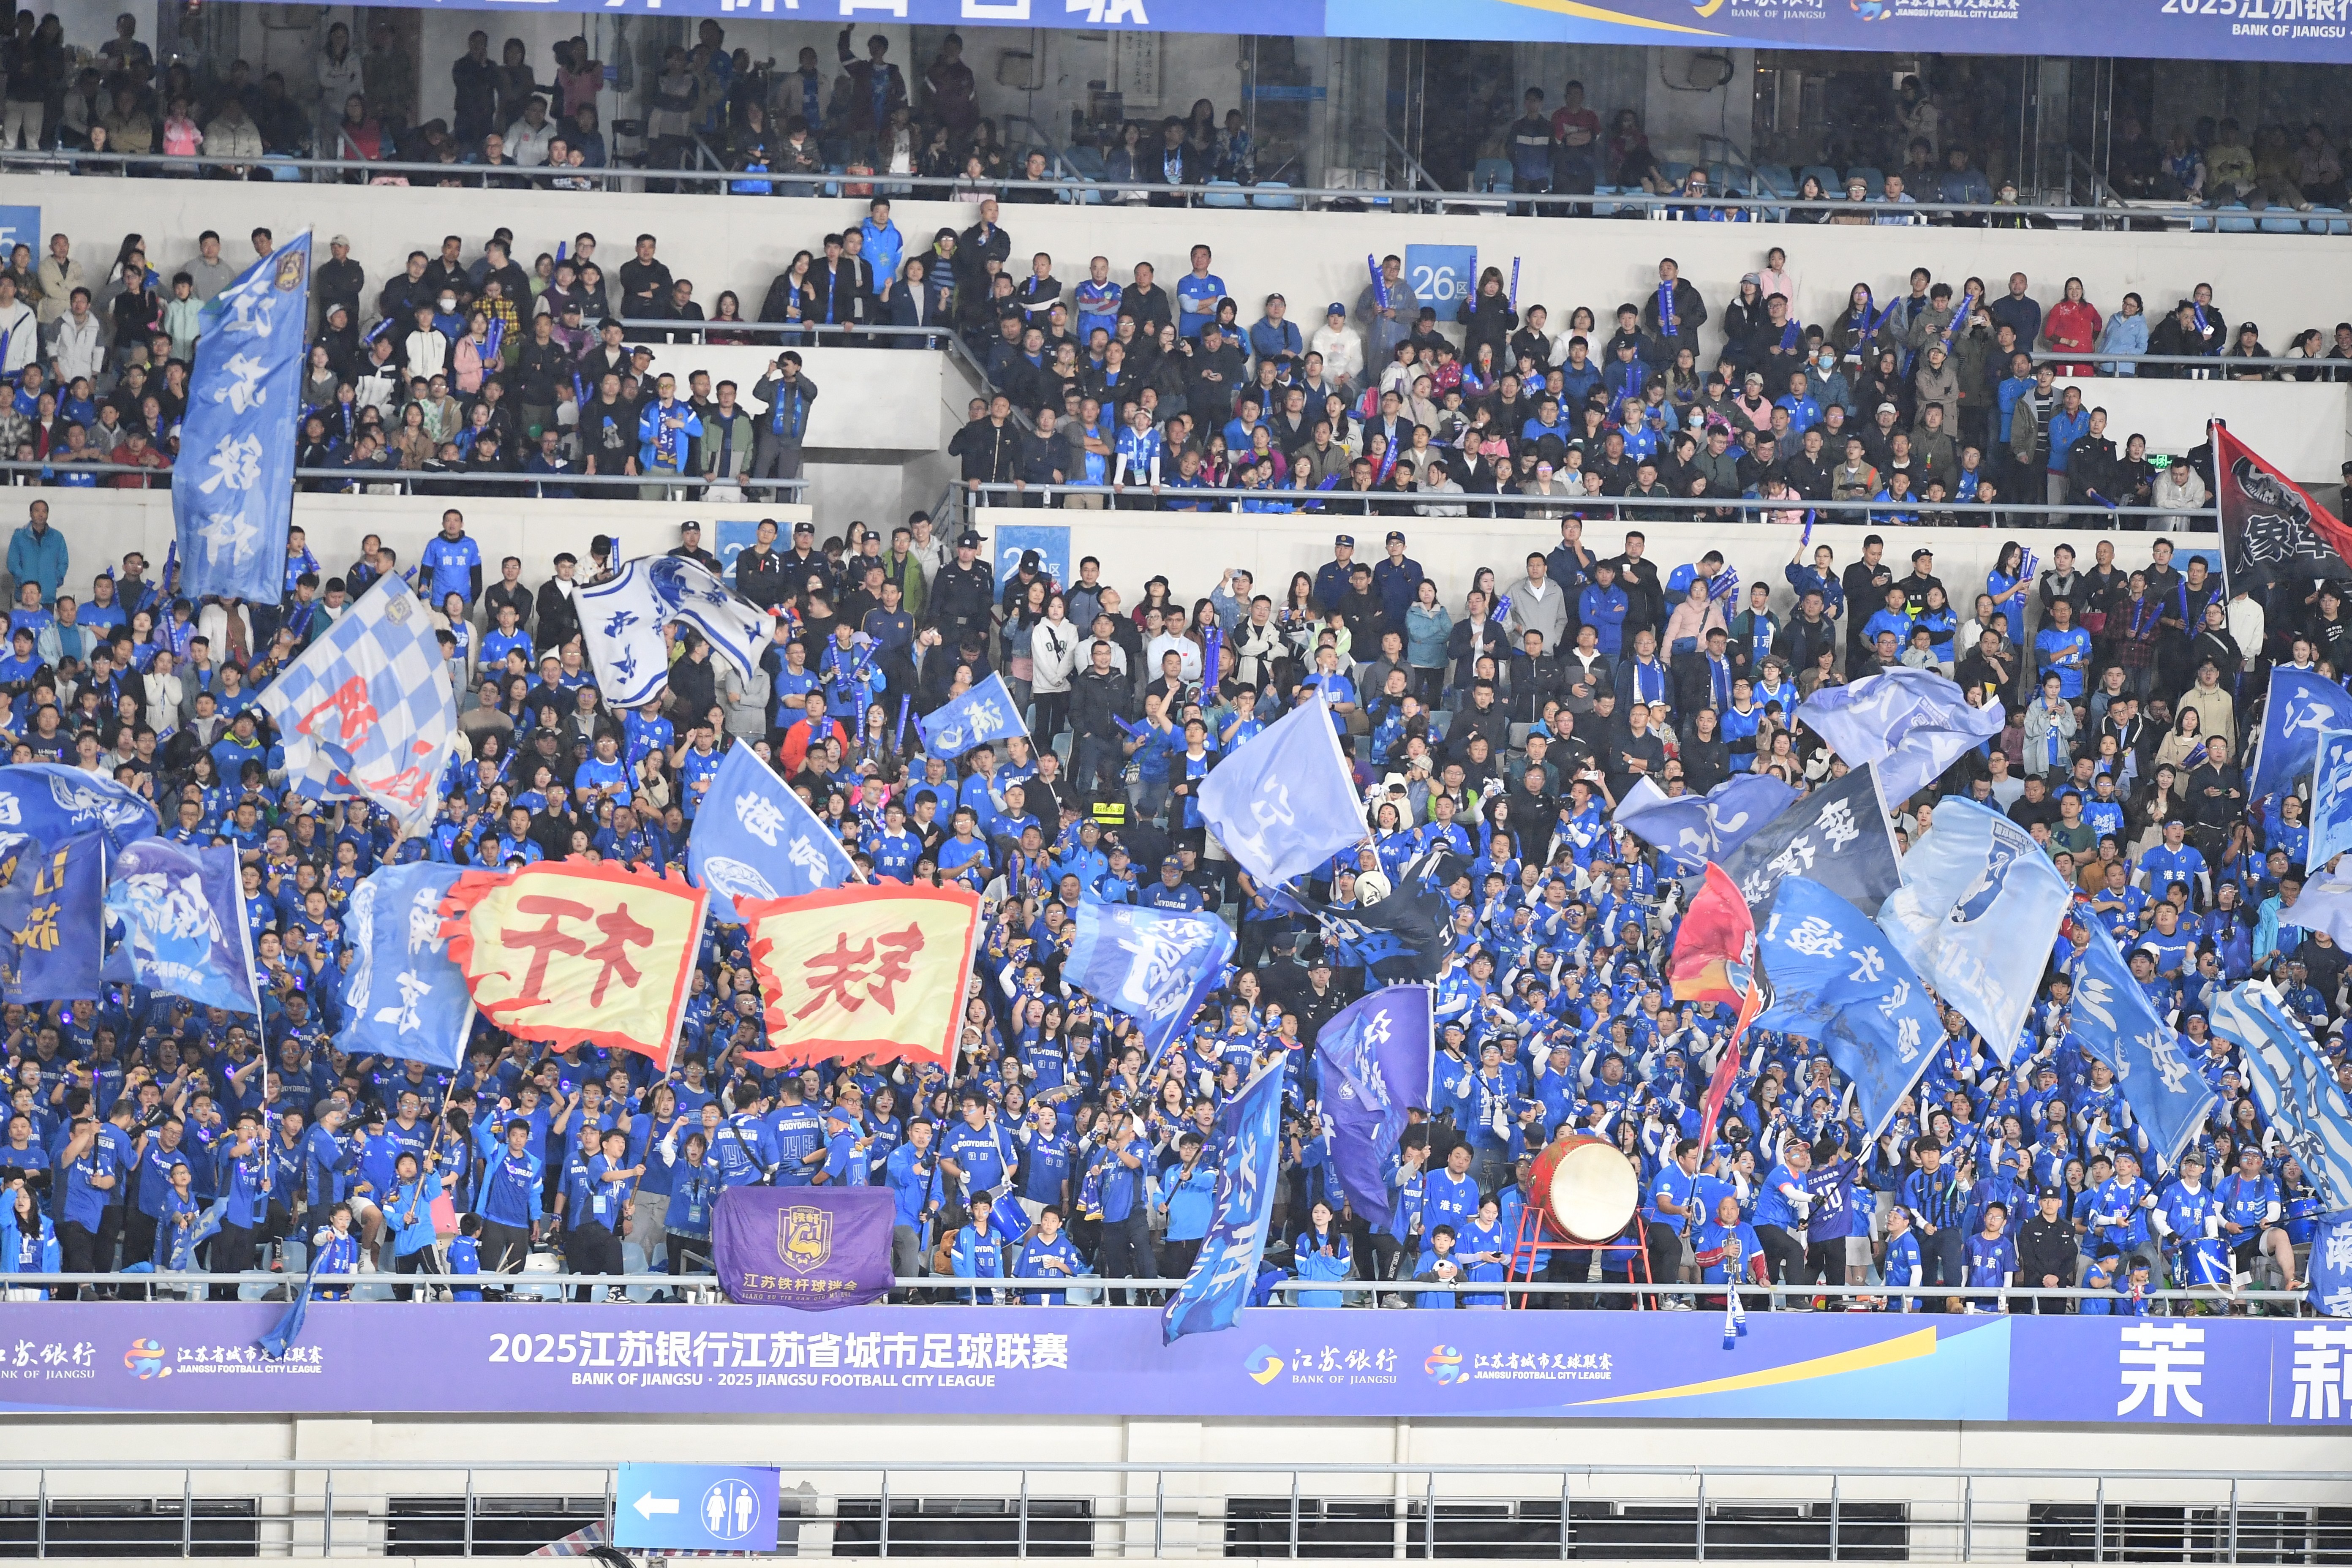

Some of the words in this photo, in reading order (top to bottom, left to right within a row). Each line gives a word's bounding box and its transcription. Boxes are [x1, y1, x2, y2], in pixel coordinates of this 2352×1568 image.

[1731, 8, 1760, 17] BANK
[1764, 10, 1778, 18] OF
[1783, 10, 1826, 19] JIANGSU
[1895, 8, 1928, 17] JIANGSU
[1929, 9, 1968, 18] FOOTBALL
[1970, 10, 1987, 19] CITY
[1988, 10, 2019, 19] LEAGUE
[2232, 24, 2268, 36] BANK
[2272, 24, 2289, 36] OF
[2291, 25, 2346, 38] JIANGSU
[1413, 265, 1456, 300] 26
[1457, 281, 1467, 294] 区
[442, 555, 466, 566] 南京
[1048, 563, 1060, 576] 区
[639, 735, 660, 748] 南京
[884, 856, 906, 866] 南京
[2163, 870, 2186, 881] 淮安
[2116, 912, 2136, 923] 淮安
[779, 1119, 818, 1132] BODYDREAM
[1439, 1199, 1463, 1216] 淮安
[1851, 1198, 1871, 1214] 南京
[2181, 1206, 2202, 1219] 南京
[2236, 1201, 2256, 1212] 南京
[792, 1212, 820, 1224] 铁杆
[1387, 1250, 1401, 1279] KELME
[1972, 1255, 1997, 1270] 南京
[743, 1272, 858, 1293] 江苏铁杆球迷会
[0, 1339, 96, 1367] 苏银行
[488, 1330, 1068, 1369] 2025江苏银行江苏省城市足球联赛
[1291, 1344, 1399, 1373] 江苏银行
[1474, 1352, 1613, 1372] 江苏省城市足球联赛
[0, 1369, 19, 1379] NK
[24, 1370, 40, 1380] OF
[45, 1369, 95, 1380] JIANGSU
[176, 1364, 217, 1374] JIANGSU
[218, 1364, 264, 1374] FOOTBALL
[264, 1364, 286, 1374] CITY
[286, 1364, 323, 1374] LEAGUE
[571, 1372, 614, 1385] BANK
[617, 1372, 638, 1386] OF
[640, 1372, 703, 1388] JIANGSU
[717, 1373, 754, 1386] 2025
[756, 1373, 818, 1388] JIANGSU
[821, 1373, 898, 1387] FOOTBALL
[901, 1374, 935, 1387] CITY
[937, 1374, 995, 1387] LEAGUE
[1291, 1375, 1324, 1384] BANK
[1328, 1375, 1345, 1384] OF
[1349, 1374, 1397, 1386] JIANGSU
[1474, 1371, 1512, 1380] JIANGSU
[1512, 1371, 1557, 1380] FOOTBALL
[1557, 1371, 1577, 1380] CITY
[1577, 1372, 1612, 1381] LEAGUE
